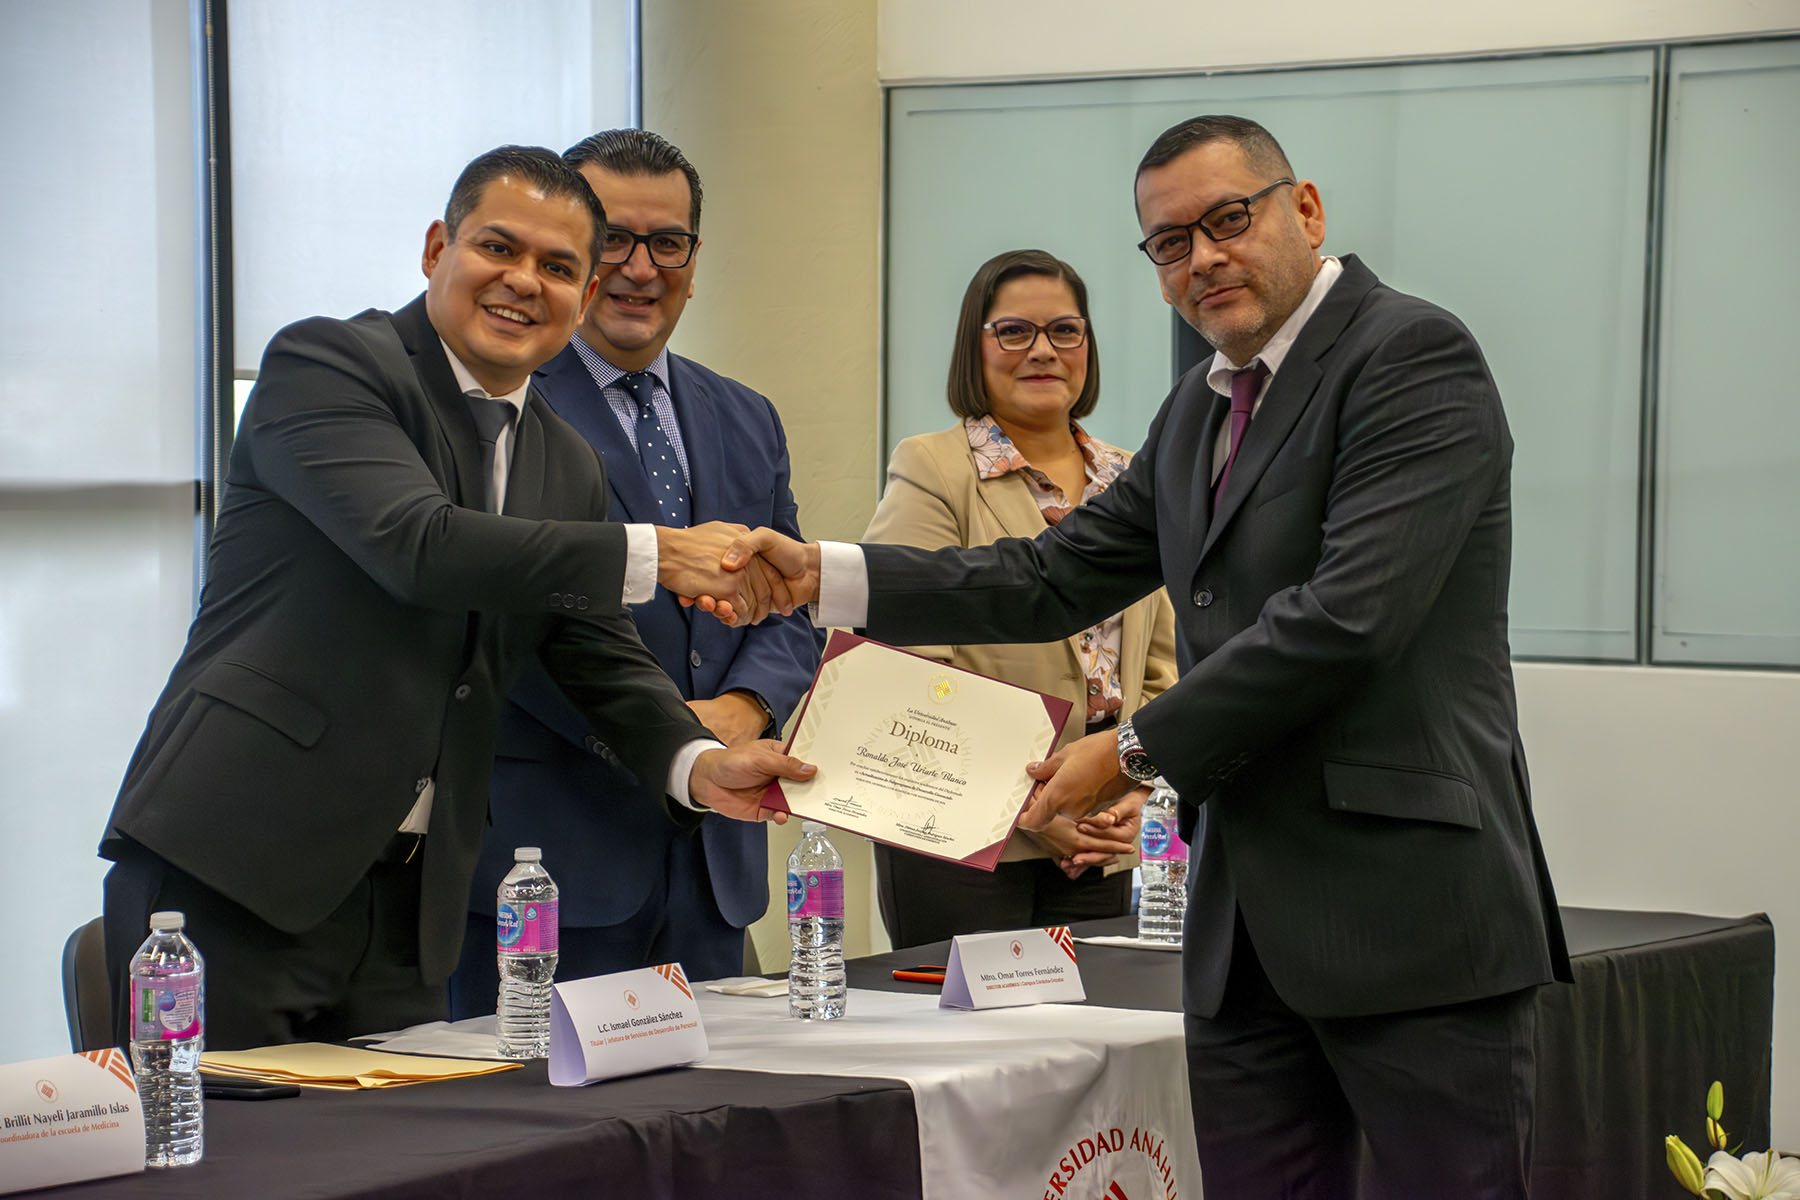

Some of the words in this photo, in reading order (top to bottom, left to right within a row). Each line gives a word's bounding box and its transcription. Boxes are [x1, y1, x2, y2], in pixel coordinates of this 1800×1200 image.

[889, 720, 959, 755] Diploma
[857, 746, 889, 763] Ronaldo
[888, 756, 908, 768] José
[911, 762, 938, 777] Uriarte
[941, 771, 967, 786] Blanco
[997, 970, 1014, 980] Omar
[1015, 969, 1034, 978] Torres
[1034, 965, 1064, 976] Fernández
[597, 1023, 610, 1033] L.C.
[610, 1020, 631, 1031] Ismael
[631, 1014, 658, 1027] González
[658, 1010, 683, 1022] Sánchez
[4, 1115, 31, 1128] Brillit
[33, 1110, 64, 1125] Nayeli
[66, 1104, 107, 1121] Jaramillo
[109, 1101, 130, 1114] Islas
[41, 1129, 49, 1137] de
[50, 1127, 57, 1136] la
[58, 1125, 80, 1136] escuela
[82, 1123, 90, 1133] de
[91, 1120, 120, 1131] Medicina
